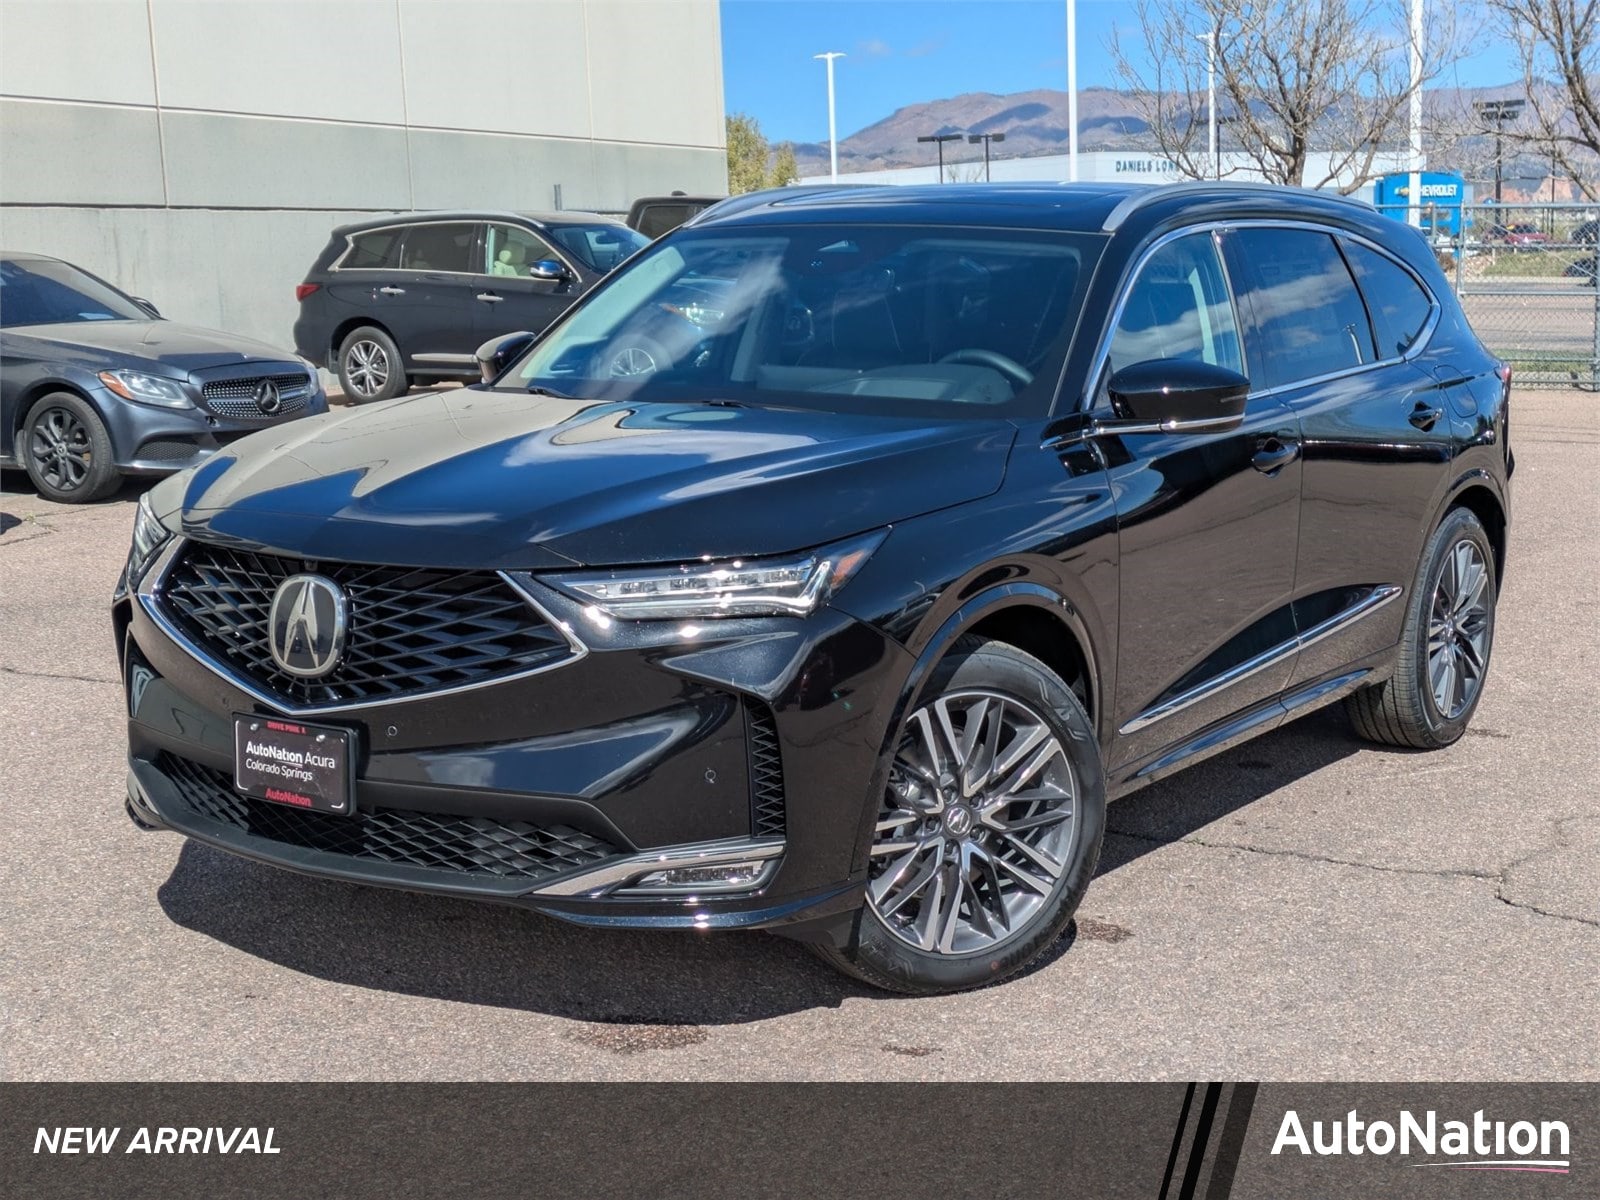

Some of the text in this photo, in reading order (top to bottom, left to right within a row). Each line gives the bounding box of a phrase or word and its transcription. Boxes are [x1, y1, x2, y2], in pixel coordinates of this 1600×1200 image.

[1116, 160, 1152, 173] DANIELS
[1419, 184, 1457, 196] HEVROLET
[246, 741, 335, 769] AutoNation Acura
[246, 758, 313, 782] Colorado Springs
[266, 788, 312, 807] AutoNation
